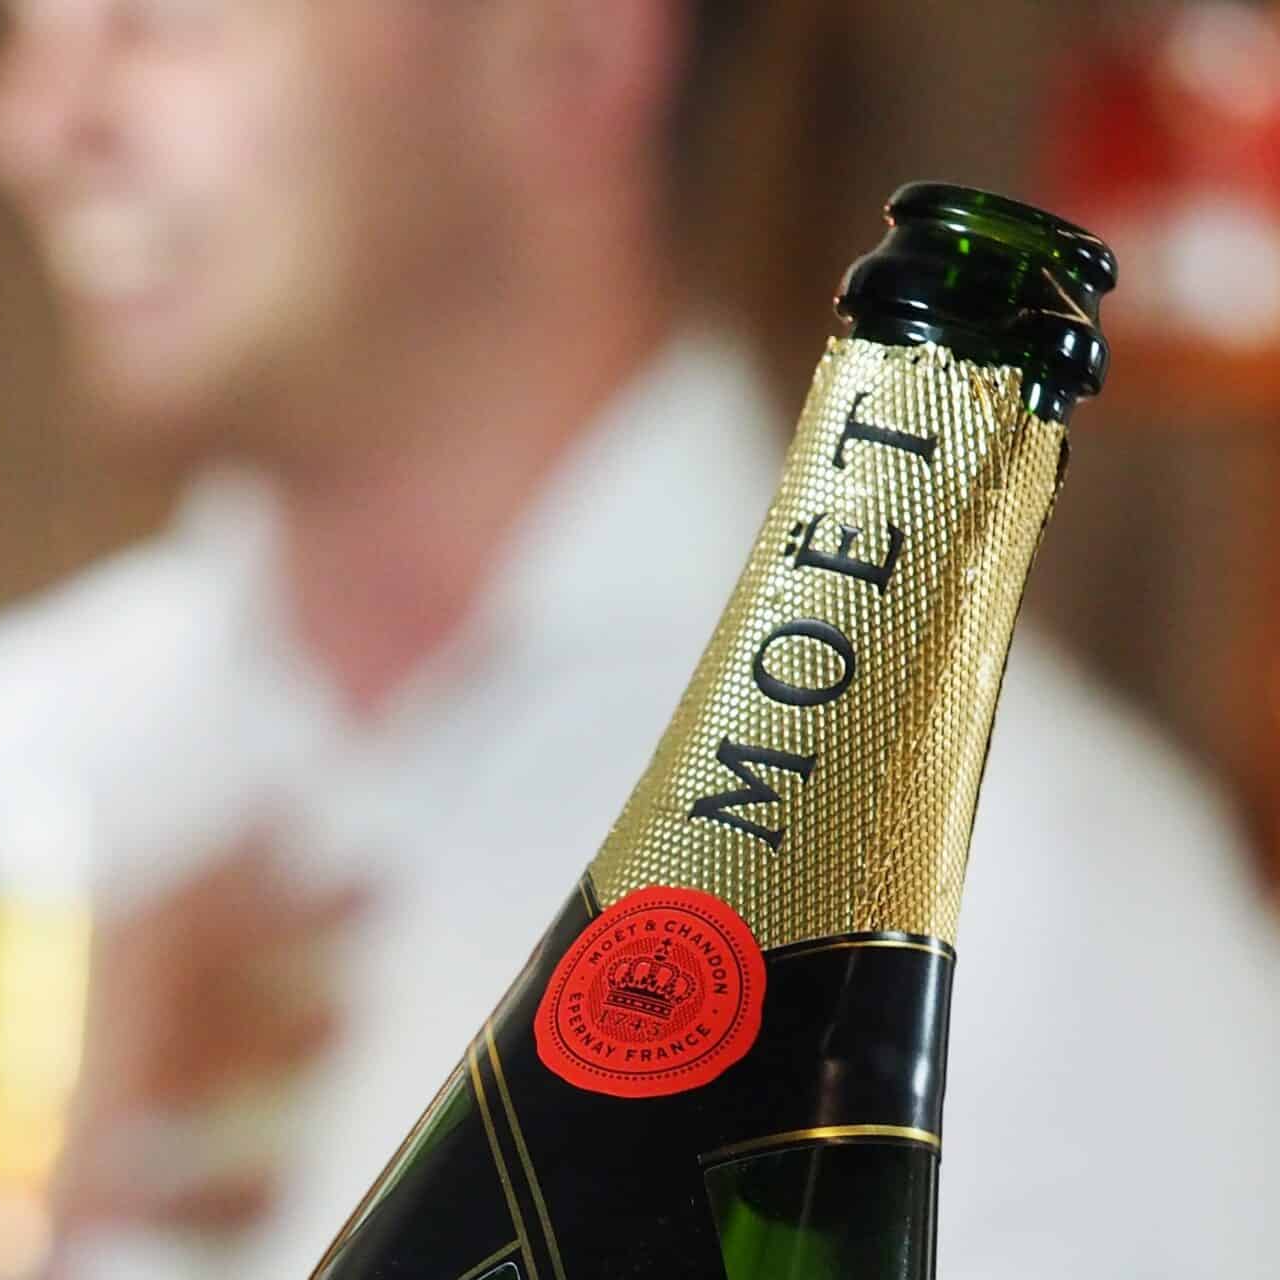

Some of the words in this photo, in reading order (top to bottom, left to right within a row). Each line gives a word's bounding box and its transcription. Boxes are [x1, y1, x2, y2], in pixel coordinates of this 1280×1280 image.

[688, 391, 938, 854] MOËT
[644, 920, 657, 932] &
[664, 920, 728, 995] CHANDON
[624, 1024, 711, 1062] FRANCE
